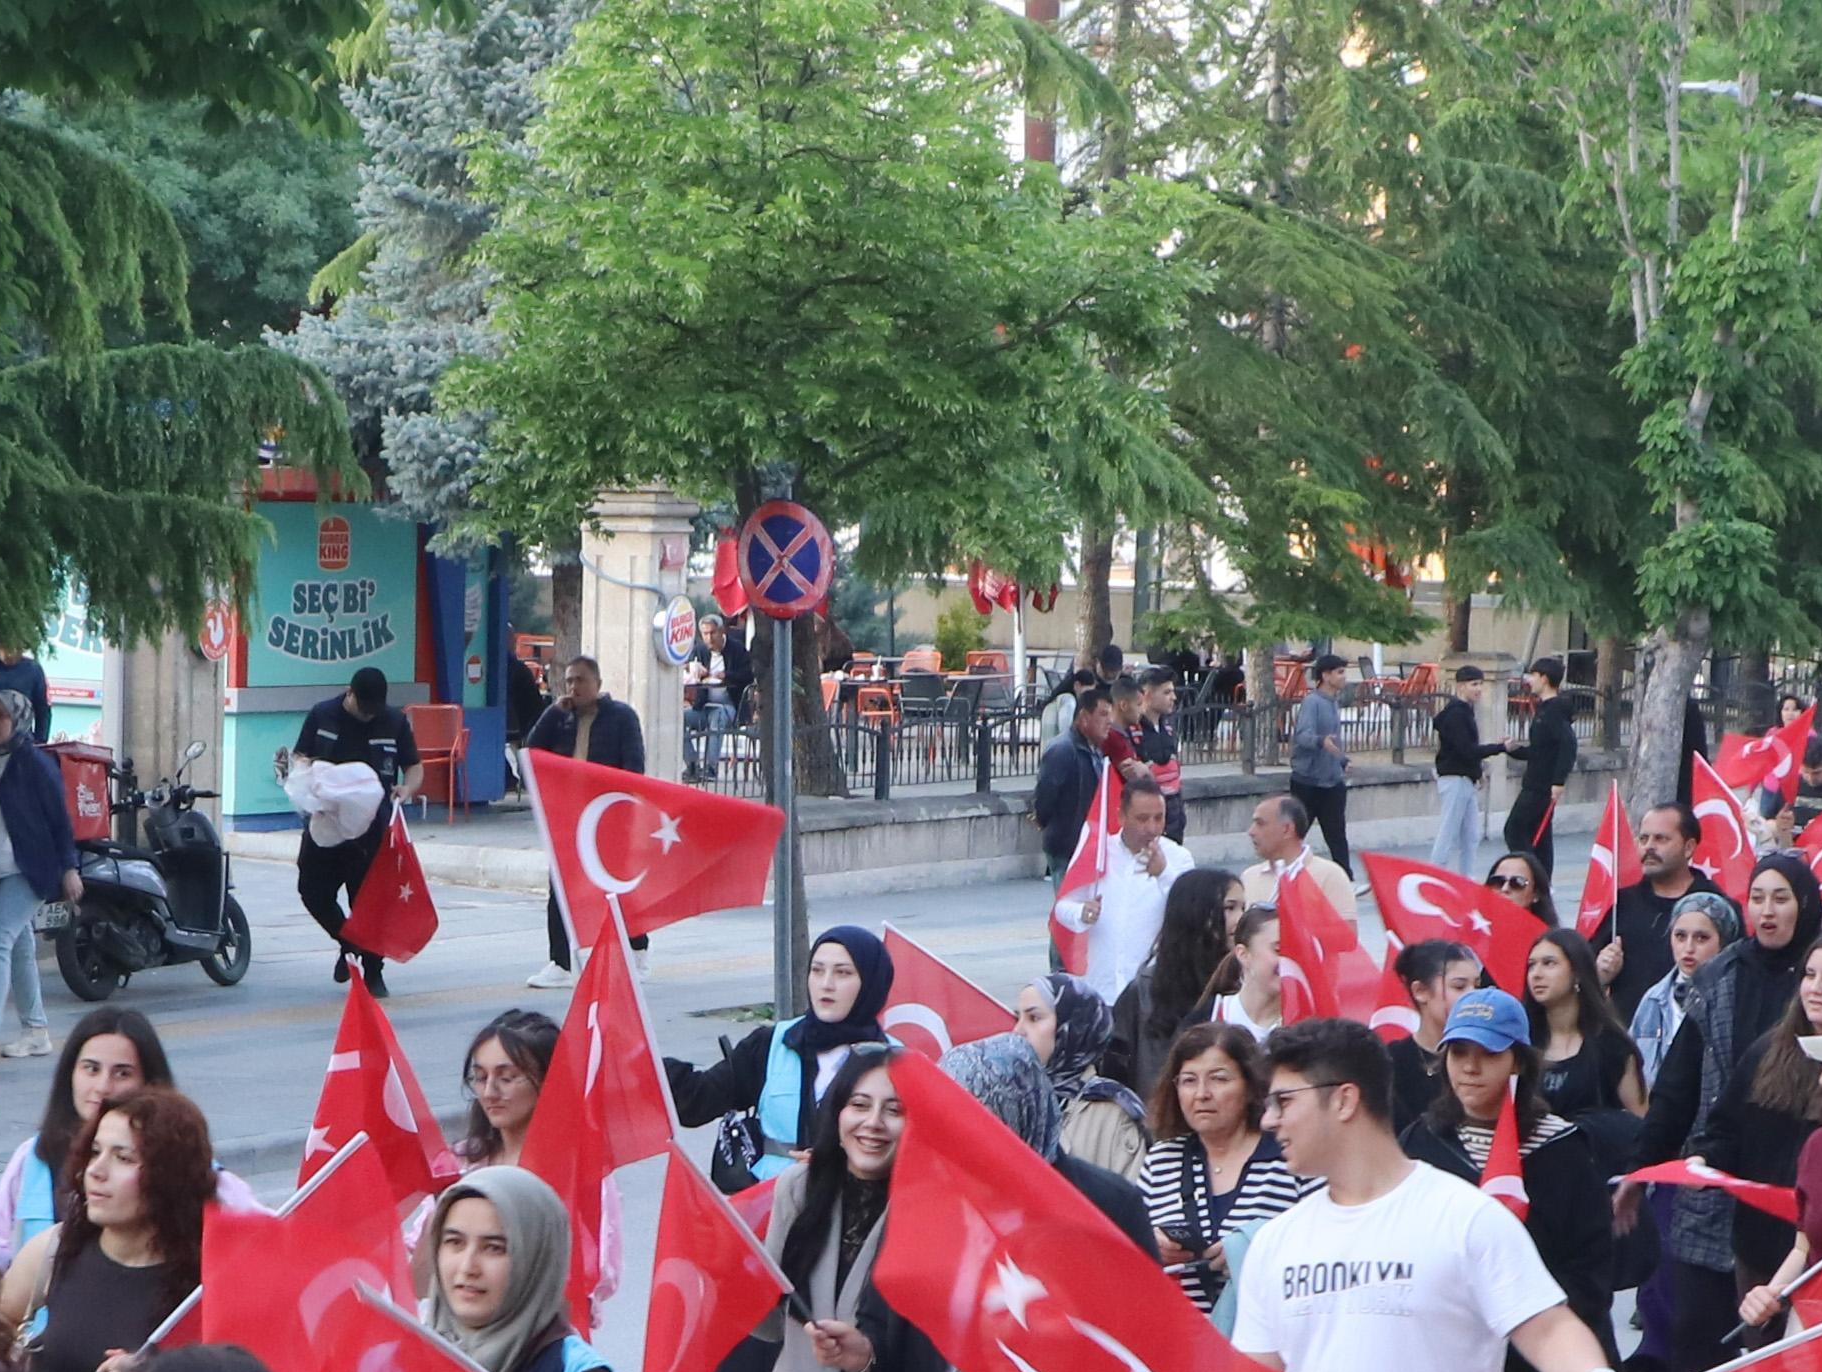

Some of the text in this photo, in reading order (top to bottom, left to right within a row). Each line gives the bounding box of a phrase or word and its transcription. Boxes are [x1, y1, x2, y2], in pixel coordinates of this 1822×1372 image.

[320, 544, 349, 560] KING
[292, 582, 339, 624] SEÇ
[267, 613, 396, 661] SERİNLİK
